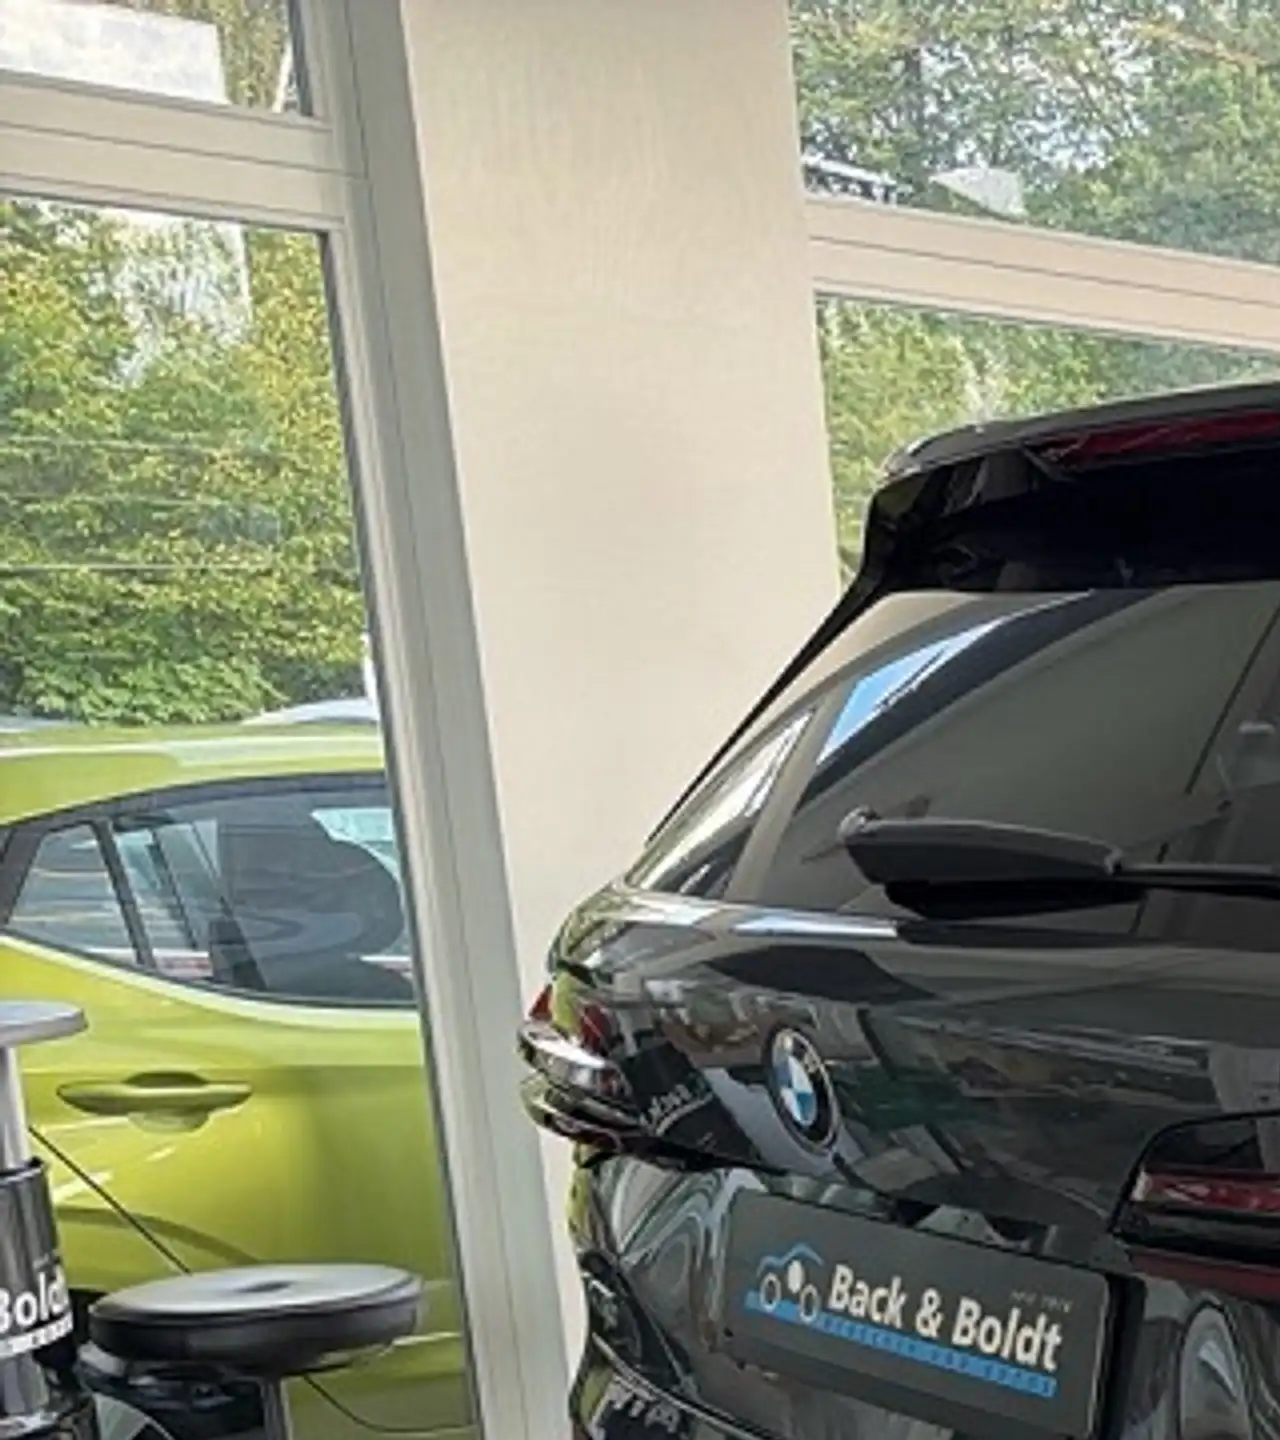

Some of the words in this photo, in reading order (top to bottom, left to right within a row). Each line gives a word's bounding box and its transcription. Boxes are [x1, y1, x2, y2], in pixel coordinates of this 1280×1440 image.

[829, 1264, 907, 1329] Back
[914, 1287, 943, 1339] &
[951, 1296, 1062, 1371] Boldt
